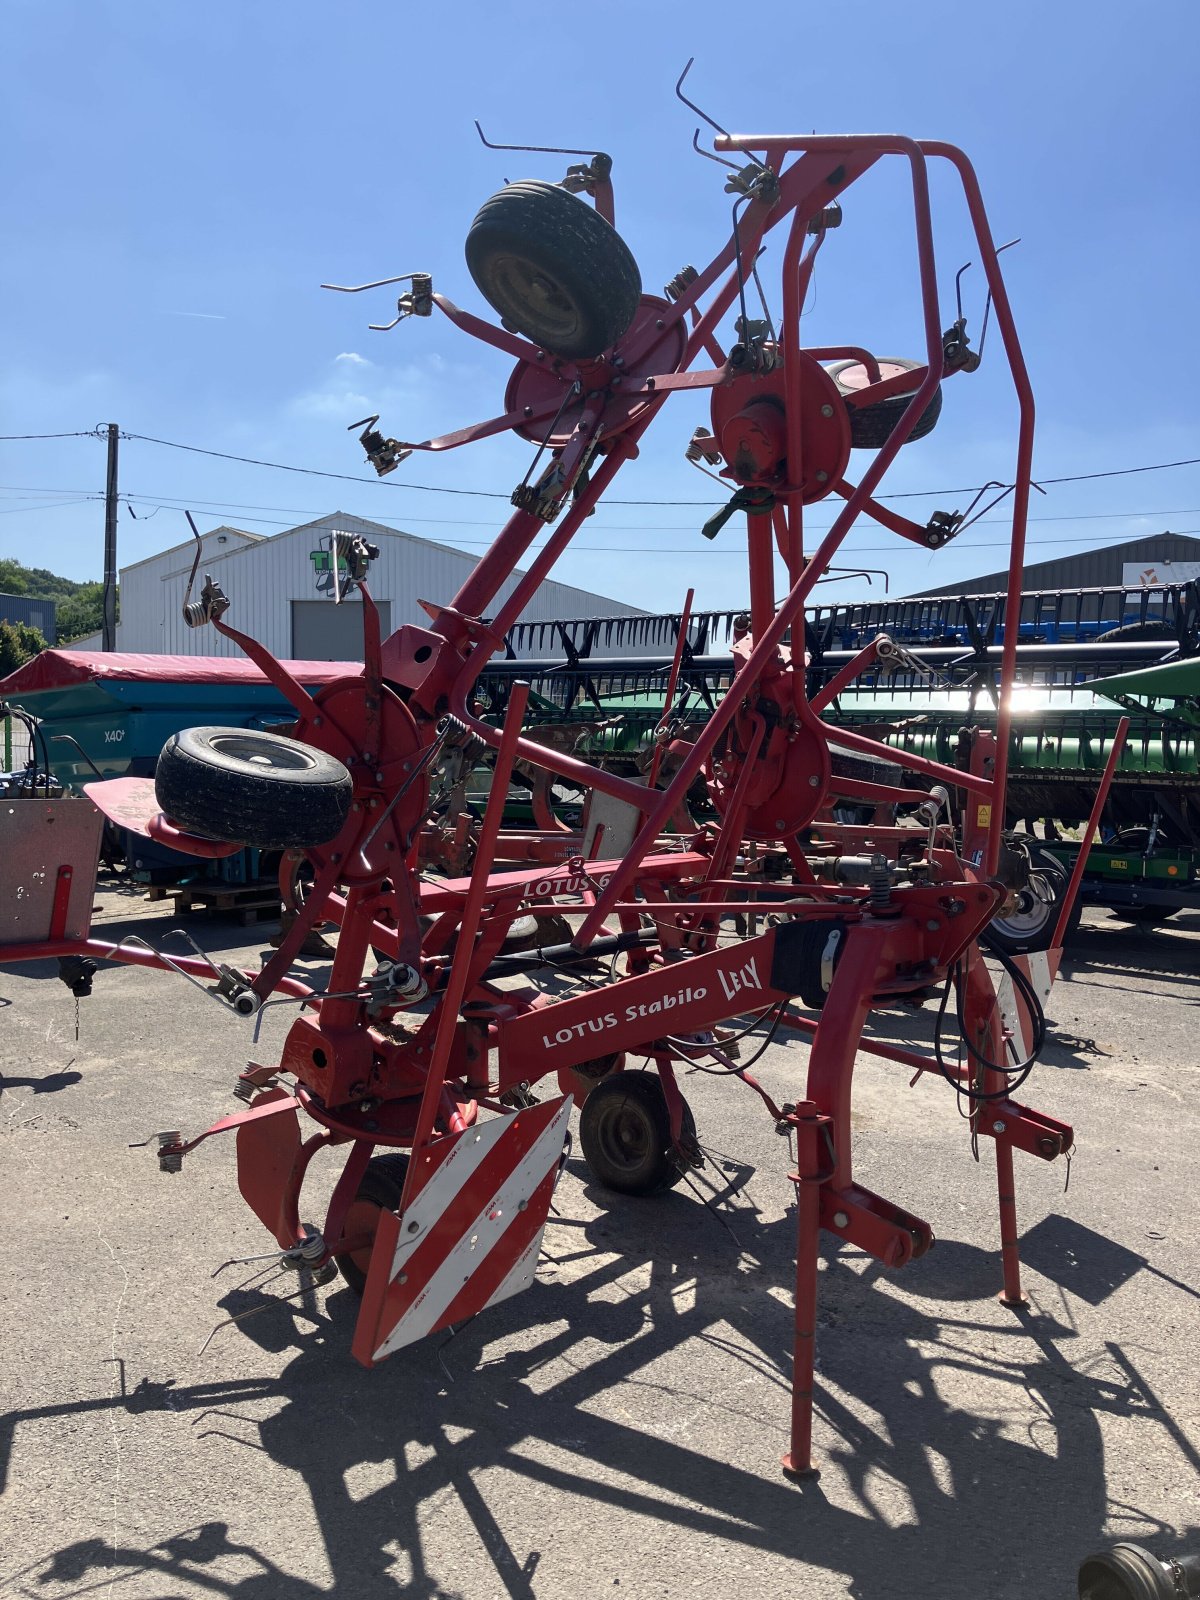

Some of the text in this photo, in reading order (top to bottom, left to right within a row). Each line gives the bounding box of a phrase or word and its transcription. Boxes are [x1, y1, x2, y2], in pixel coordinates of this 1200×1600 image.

[523, 877, 590, 897] LOTUS
[542, 956, 763, 1049] LOTUS Stabilo LELY
